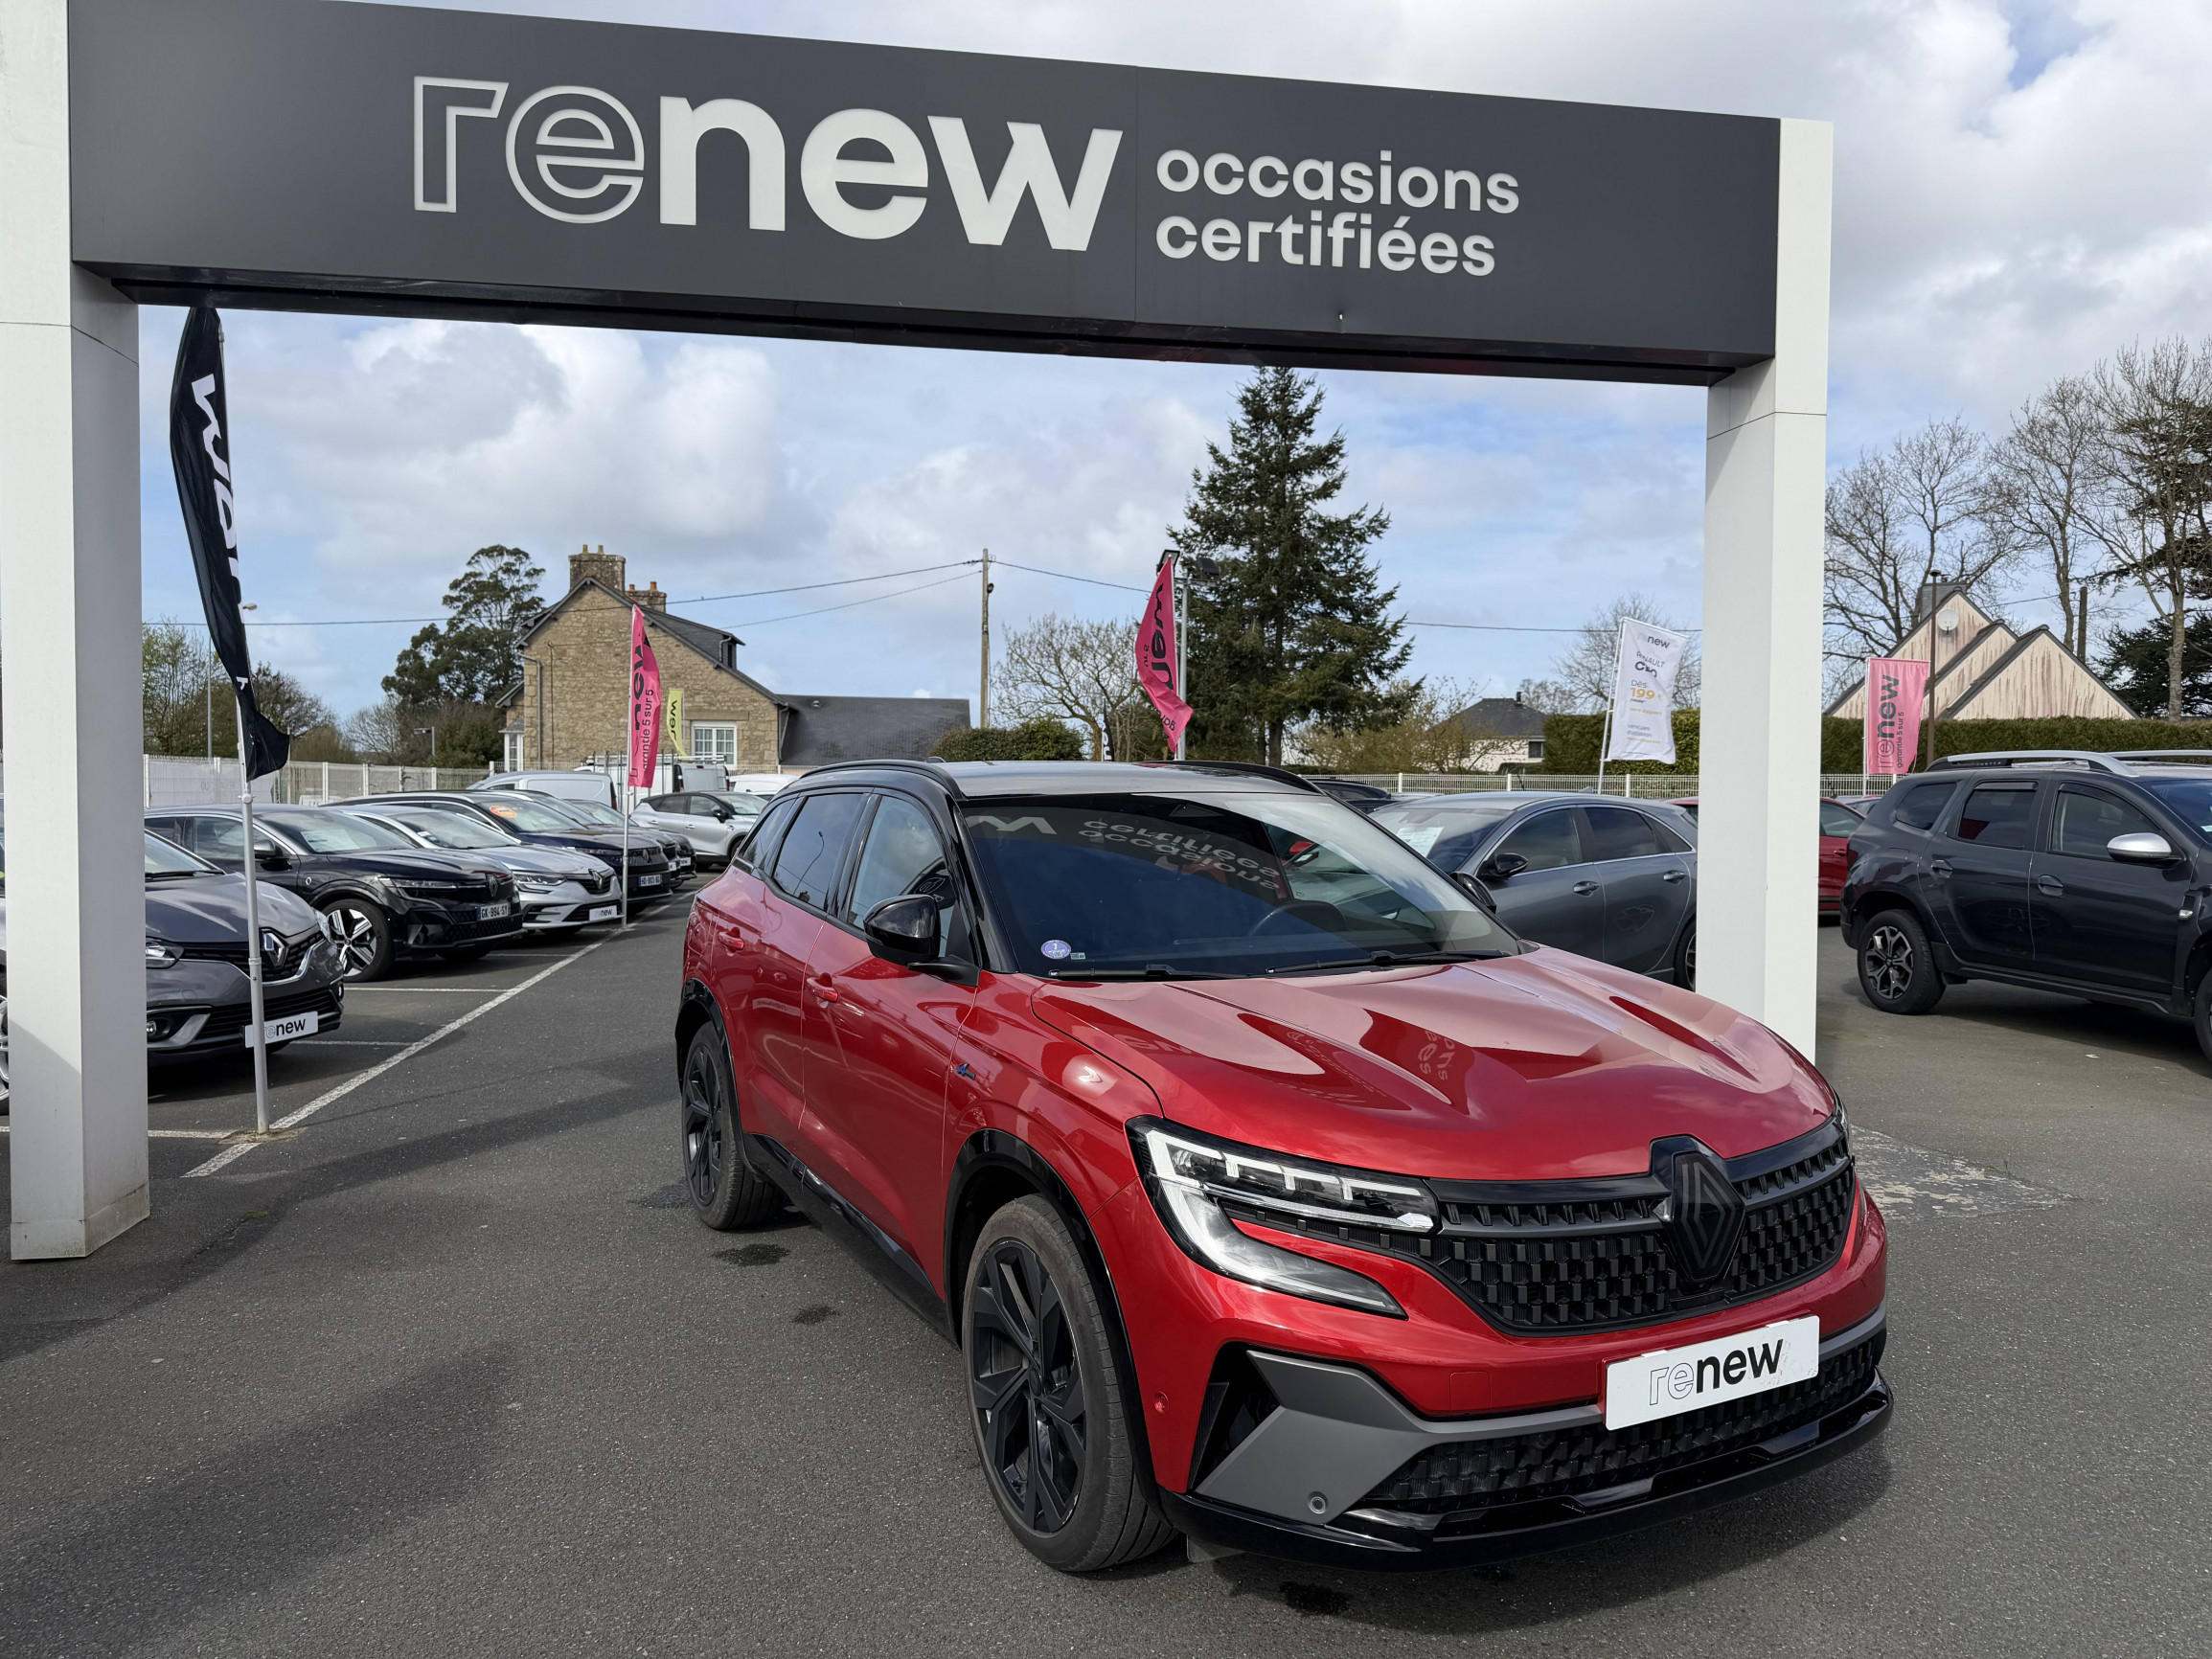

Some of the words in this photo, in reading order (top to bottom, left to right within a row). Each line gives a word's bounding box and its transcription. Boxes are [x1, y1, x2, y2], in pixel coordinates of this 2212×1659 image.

[414, 76, 1123, 252] renew
[1155, 149, 1520, 215] occasions
[1155, 208, 1495, 277] certifiées
[644, 698, 652, 717] sur
[1630, 687, 1655, 700] 199
[1877, 674, 1900, 768] renew
[264, 1018, 307, 1039] enew
[1649, 1338, 1784, 1406] renew
